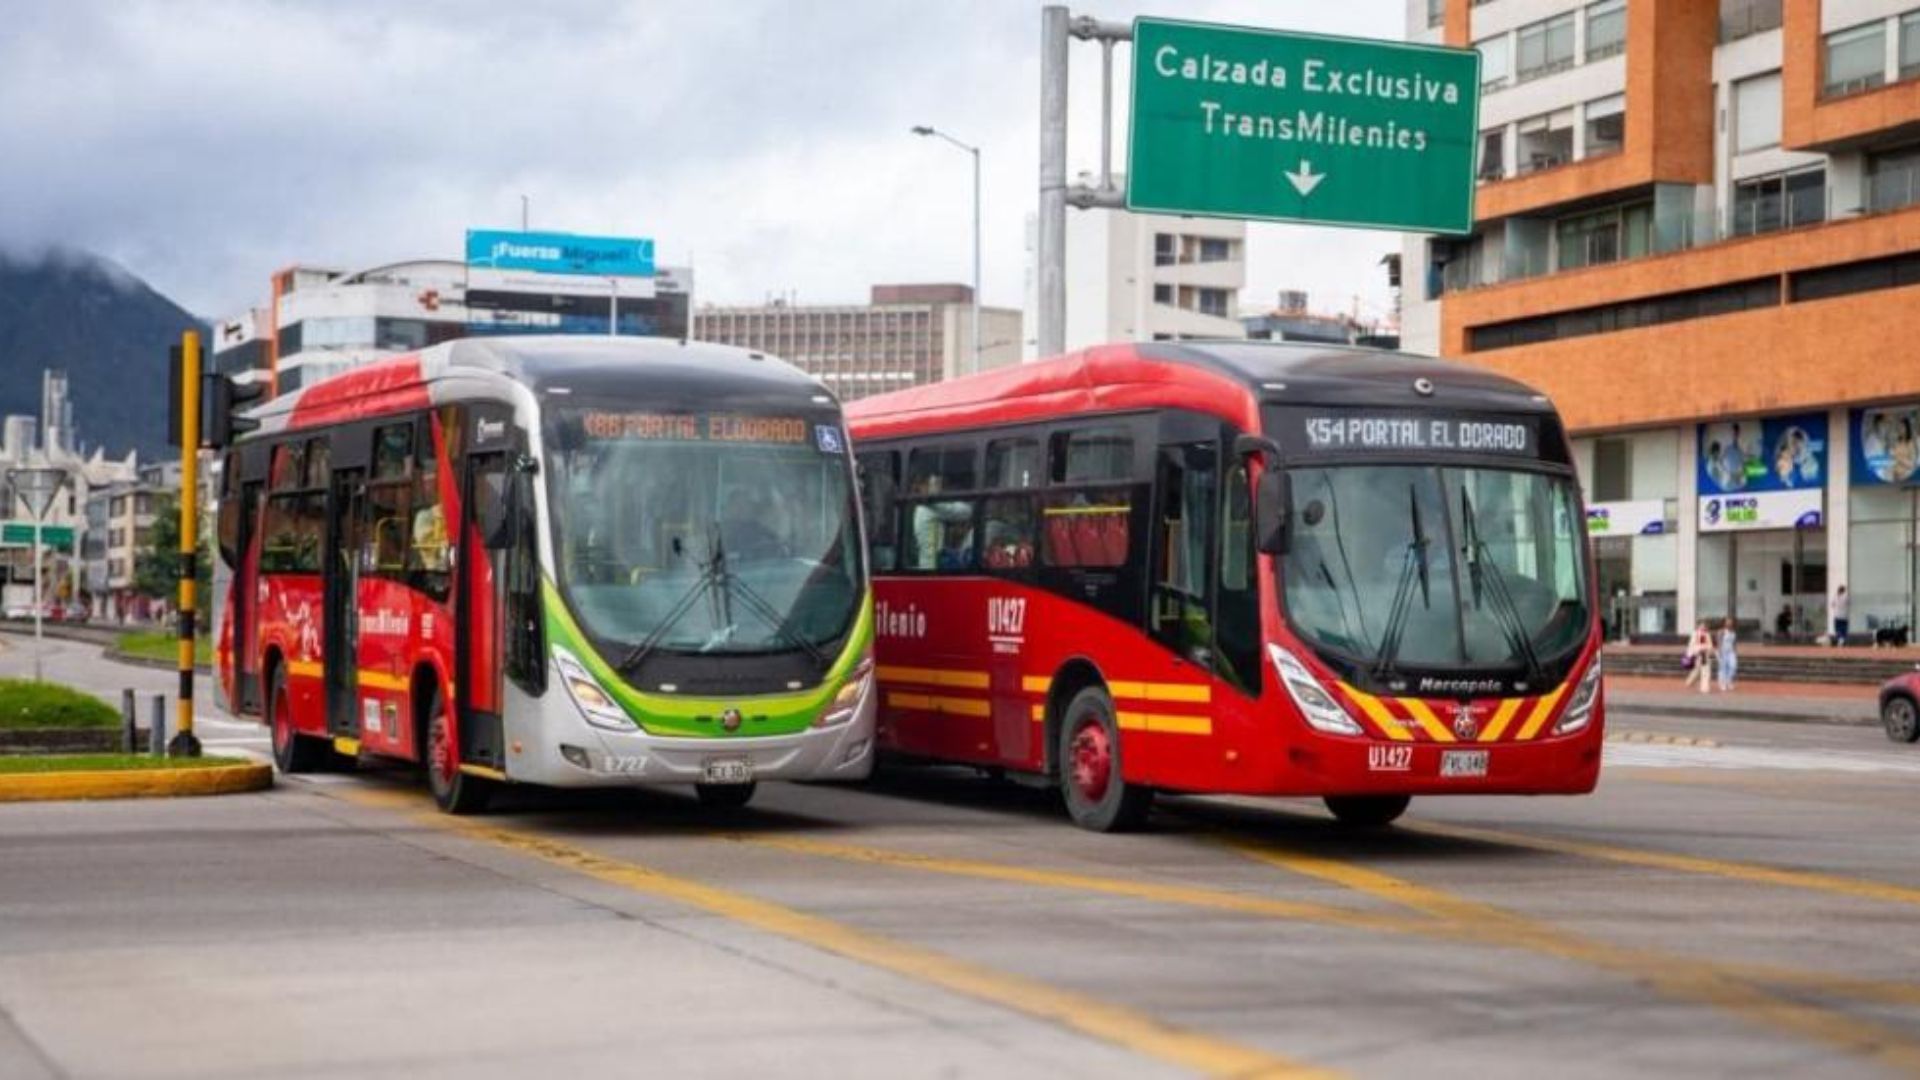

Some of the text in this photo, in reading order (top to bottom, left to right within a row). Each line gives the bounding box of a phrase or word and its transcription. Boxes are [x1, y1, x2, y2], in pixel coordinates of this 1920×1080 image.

[1155, 46, 1458, 104] Calzada Exclusiva
[1306, 418, 1526, 450] K54 PORTAL EL DORADO
[875, 601, 926, 637] ilenio
[988, 598, 1026, 633] U1427
[1368, 746, 1413, 768] U1427
